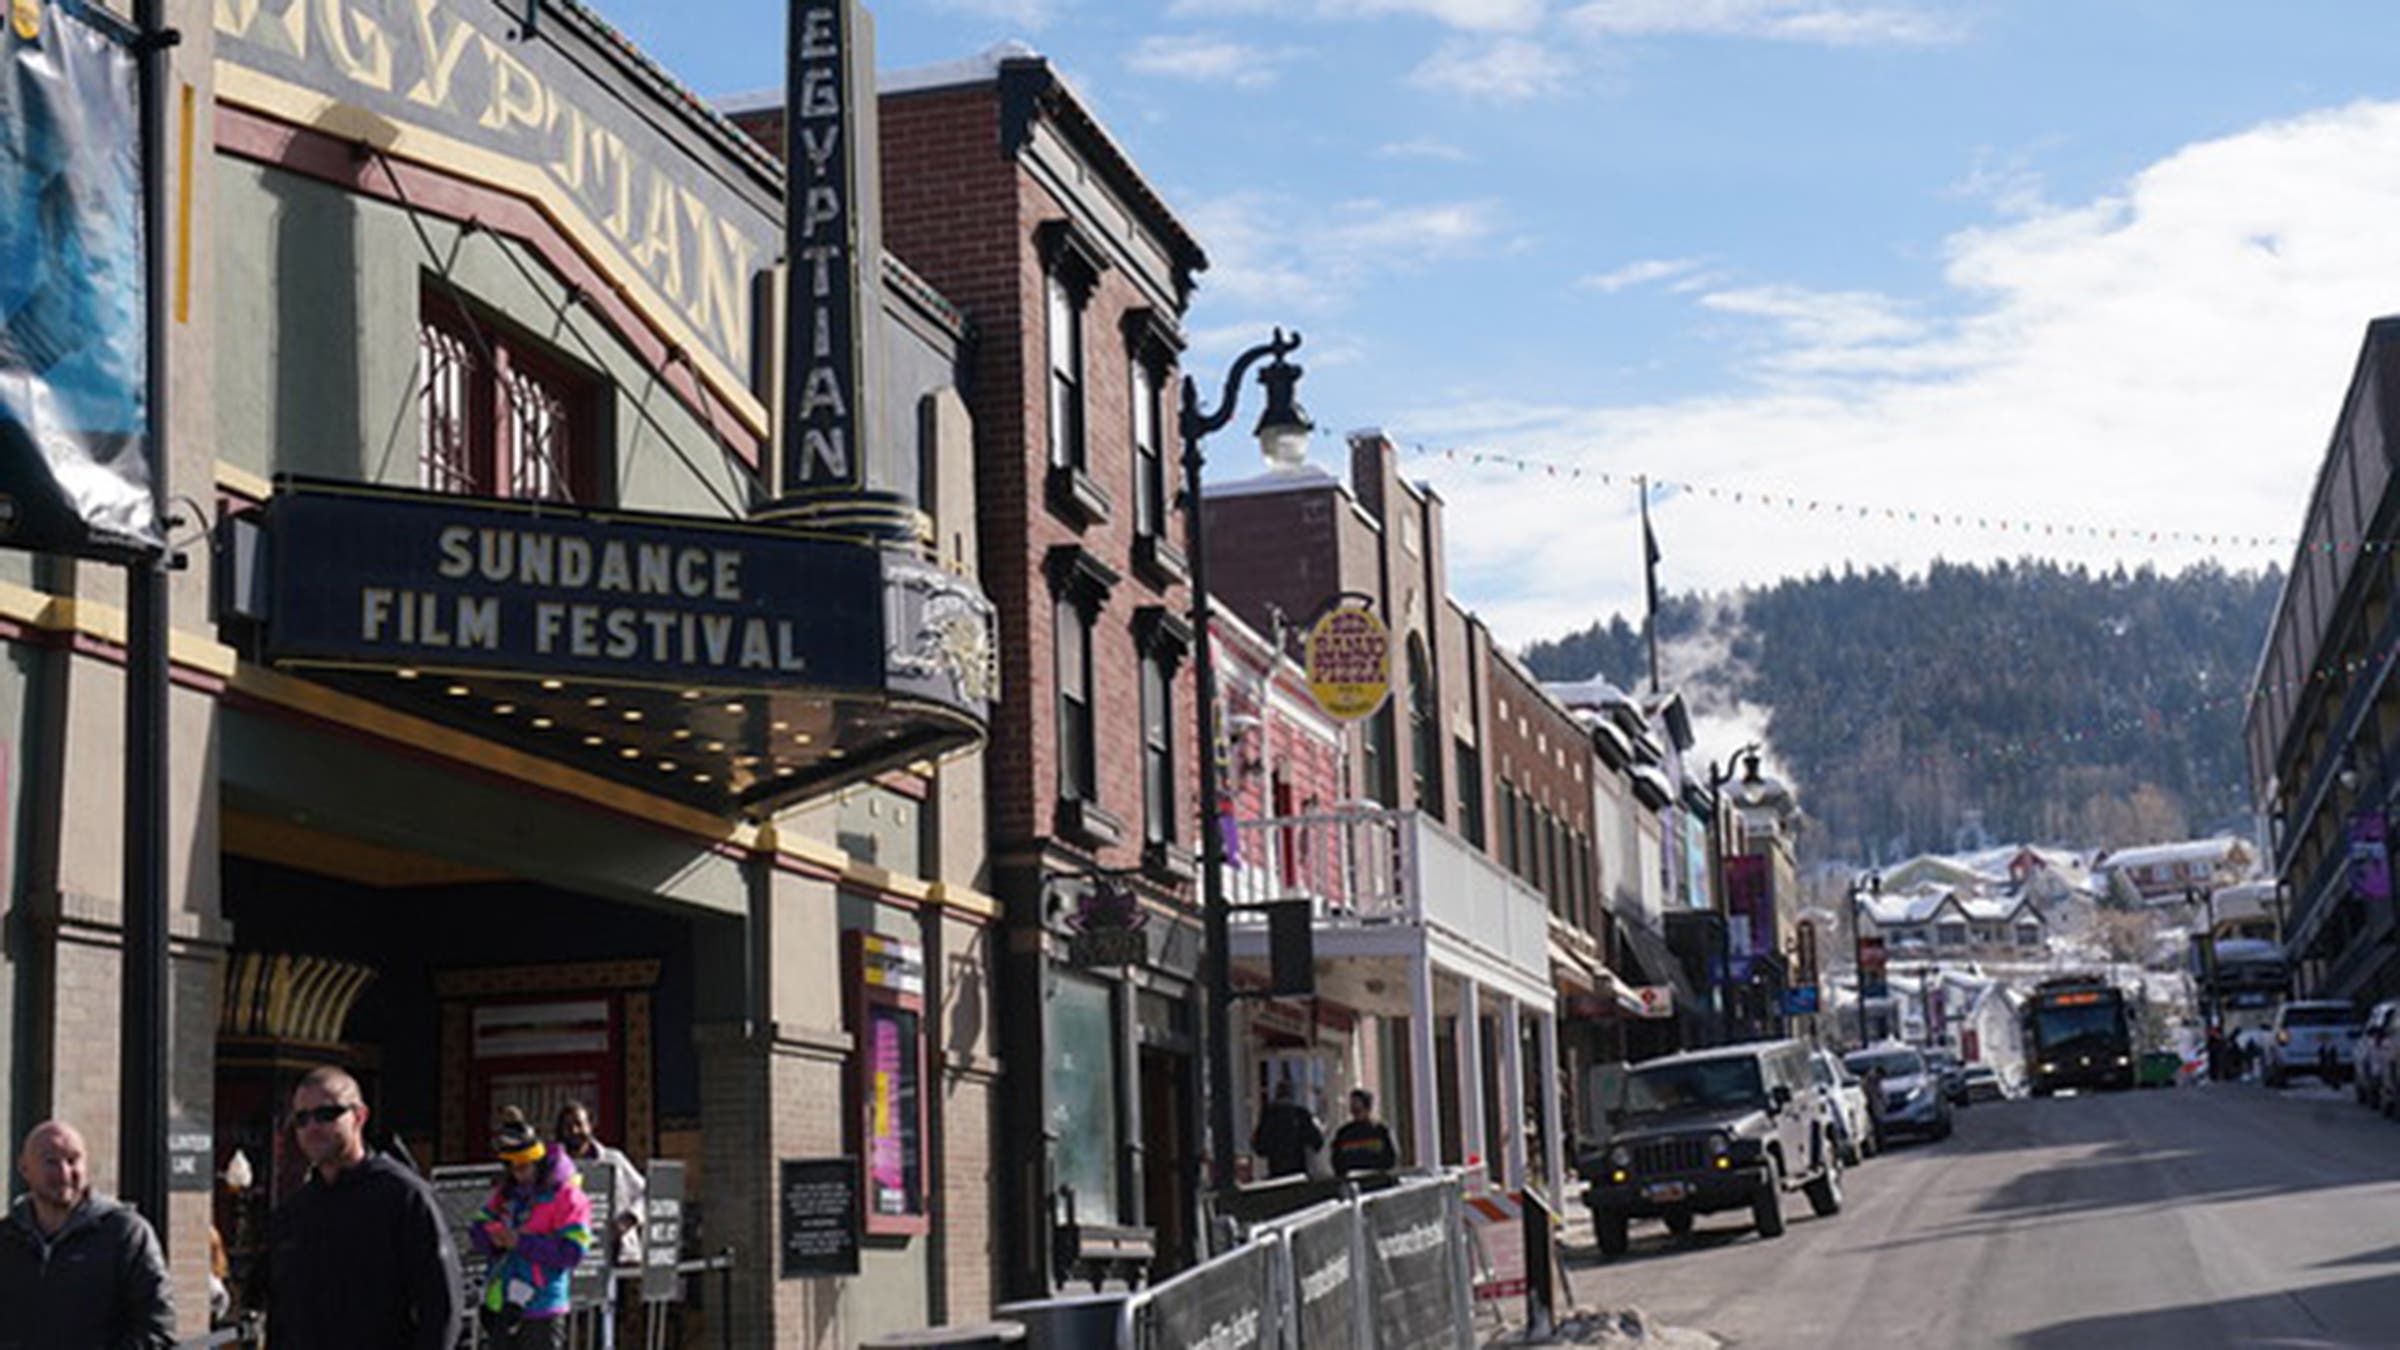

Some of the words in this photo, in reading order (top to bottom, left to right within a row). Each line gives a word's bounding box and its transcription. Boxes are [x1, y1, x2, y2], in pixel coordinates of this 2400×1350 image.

[800, 8, 848, 481] EGYPTIAN
[437, 525, 743, 602] SUNDANCE
[361, 587, 501, 650] FILM
[536, 601, 806, 672] FESTIVAL
